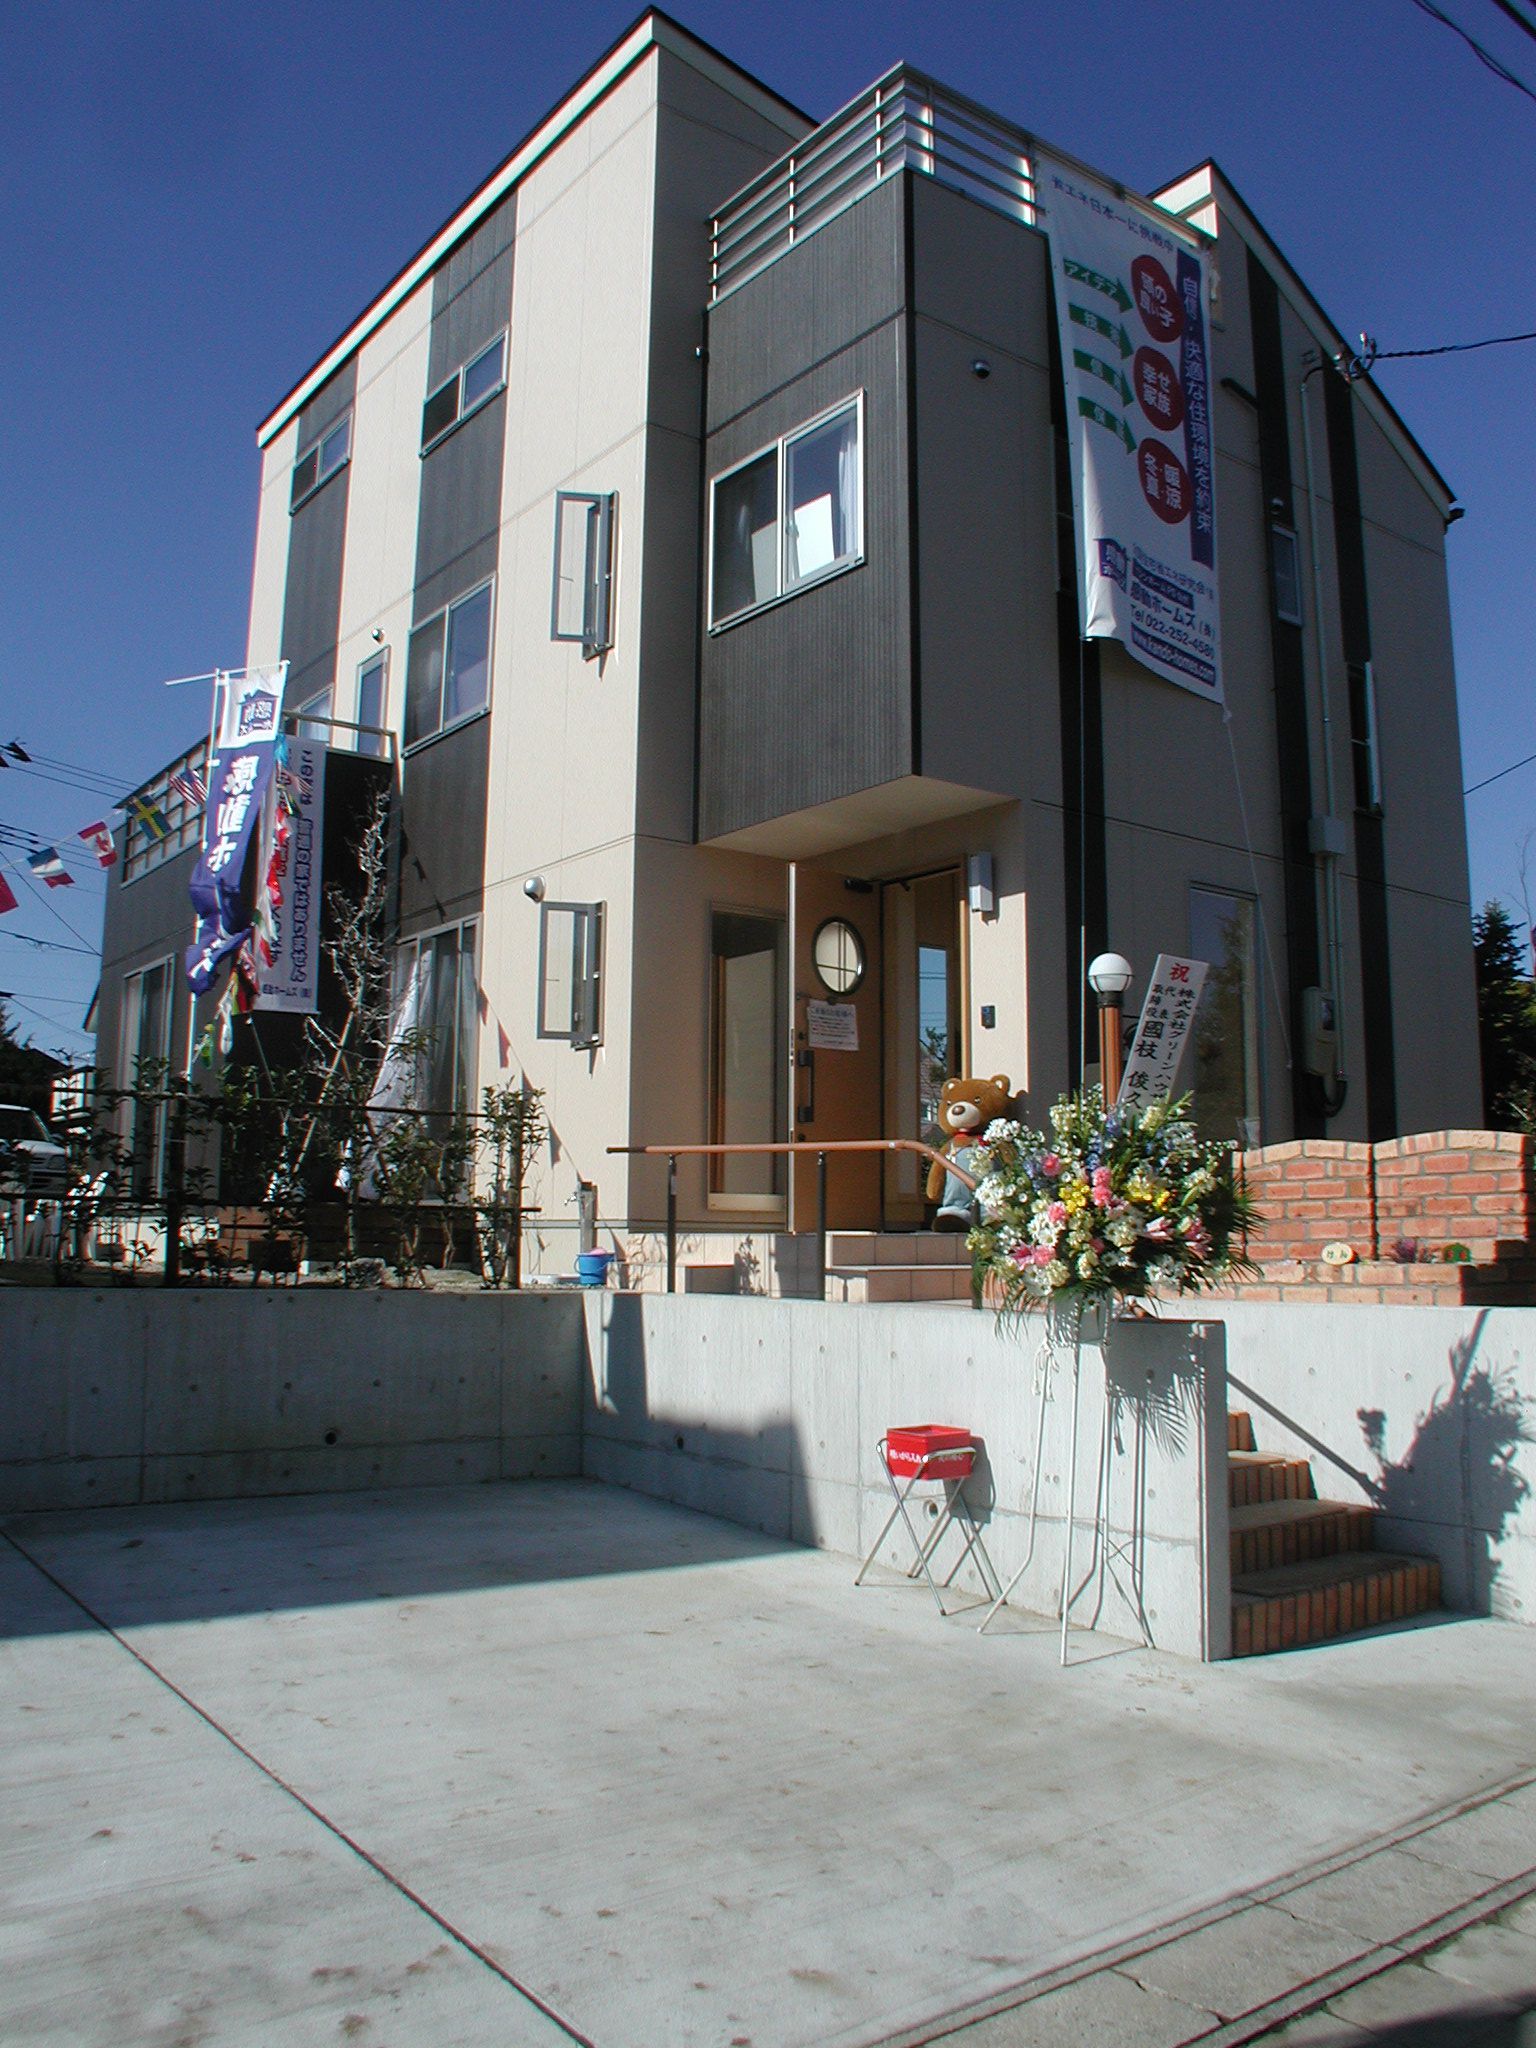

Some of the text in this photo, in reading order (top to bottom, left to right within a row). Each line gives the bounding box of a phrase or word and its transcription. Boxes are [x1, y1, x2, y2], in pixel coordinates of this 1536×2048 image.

[1064, 262, 1118, 297] アイデア
[1131, 604, 1144, 622] Tel
[1169, 962, 1191, 983] 祝
